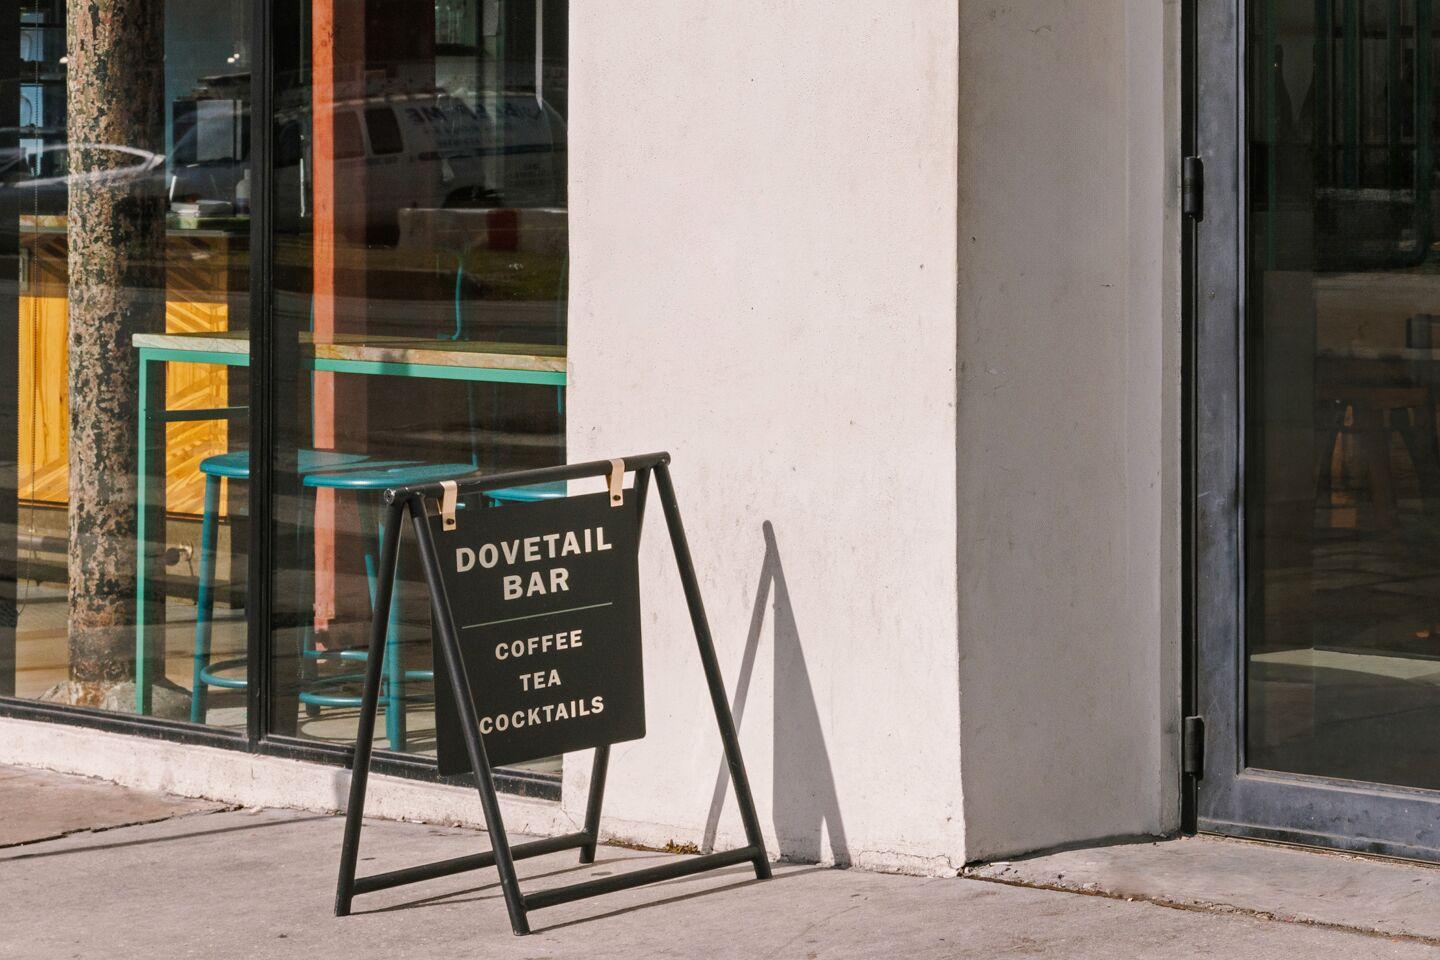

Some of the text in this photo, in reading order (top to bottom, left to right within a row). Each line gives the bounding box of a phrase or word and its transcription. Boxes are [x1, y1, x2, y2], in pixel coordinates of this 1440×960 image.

[456, 526, 613, 573] DOVETAIL
[503, 567, 570, 601] BAR
[495, 629, 583, 661] COFFEE
[519, 668, 562, 692] TEA
[479, 695, 604, 735] COCKTAILS
